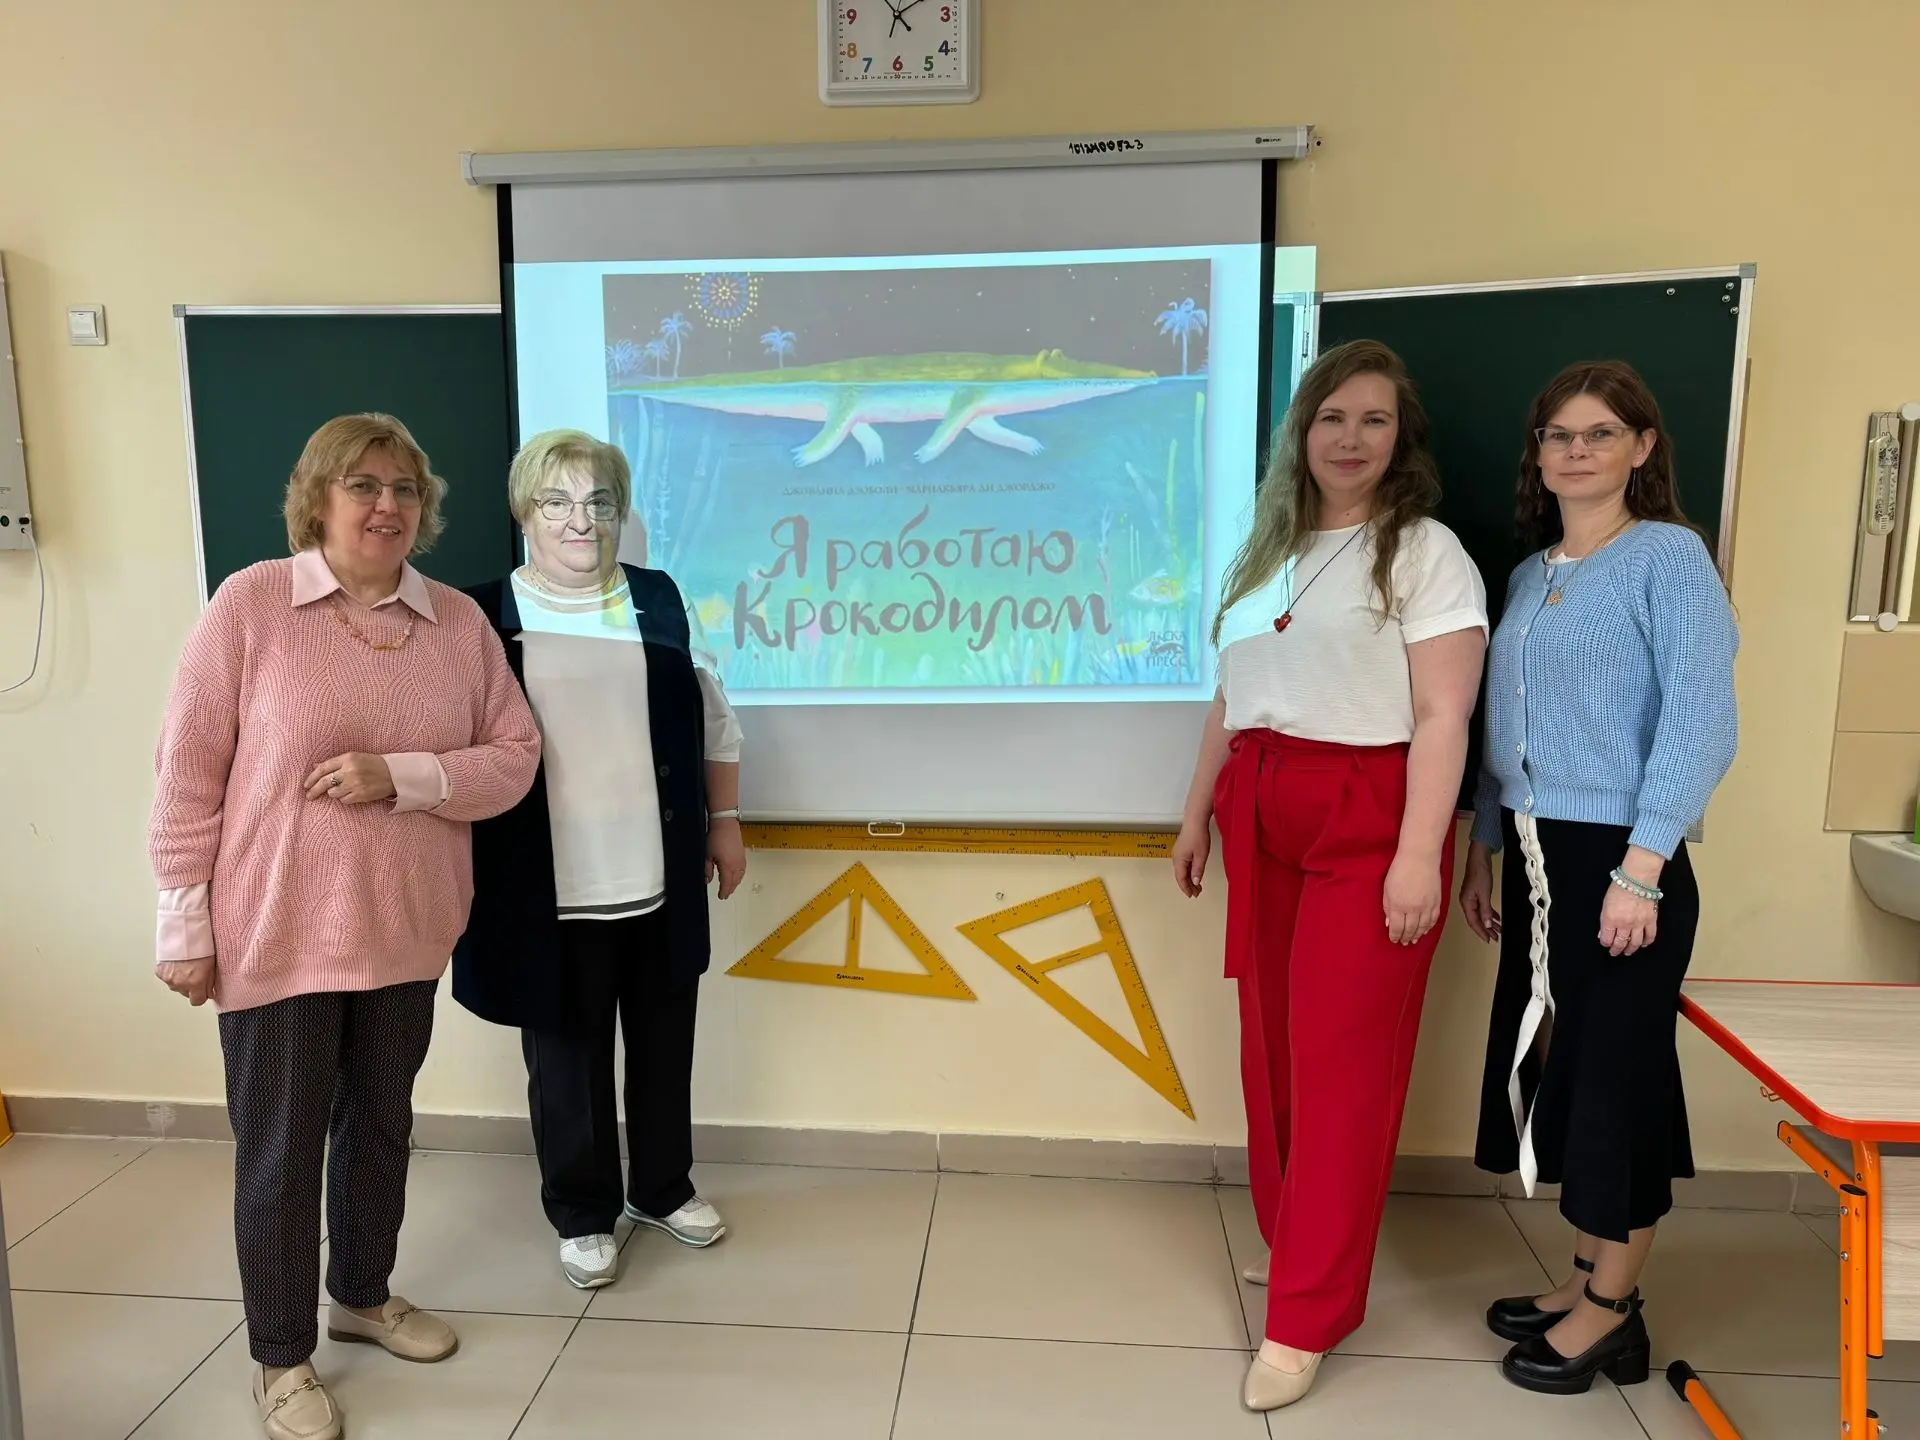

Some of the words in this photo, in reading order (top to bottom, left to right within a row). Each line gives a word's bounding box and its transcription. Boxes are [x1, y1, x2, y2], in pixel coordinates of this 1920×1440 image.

[846, 8, 857, 25] 9
[940, 6, 951, 22] 3
[846, 42, 857, 59] 8
[938, 39, 951, 56] 4
[862, 57, 873, 73] 7
[892, 55, 903, 71] 6
[923, 55, 934, 71] 5
[757, 513, 810, 579] Я
[826, 504, 1075, 592] работаю
[733, 572, 1112, 652] Крокодилом
